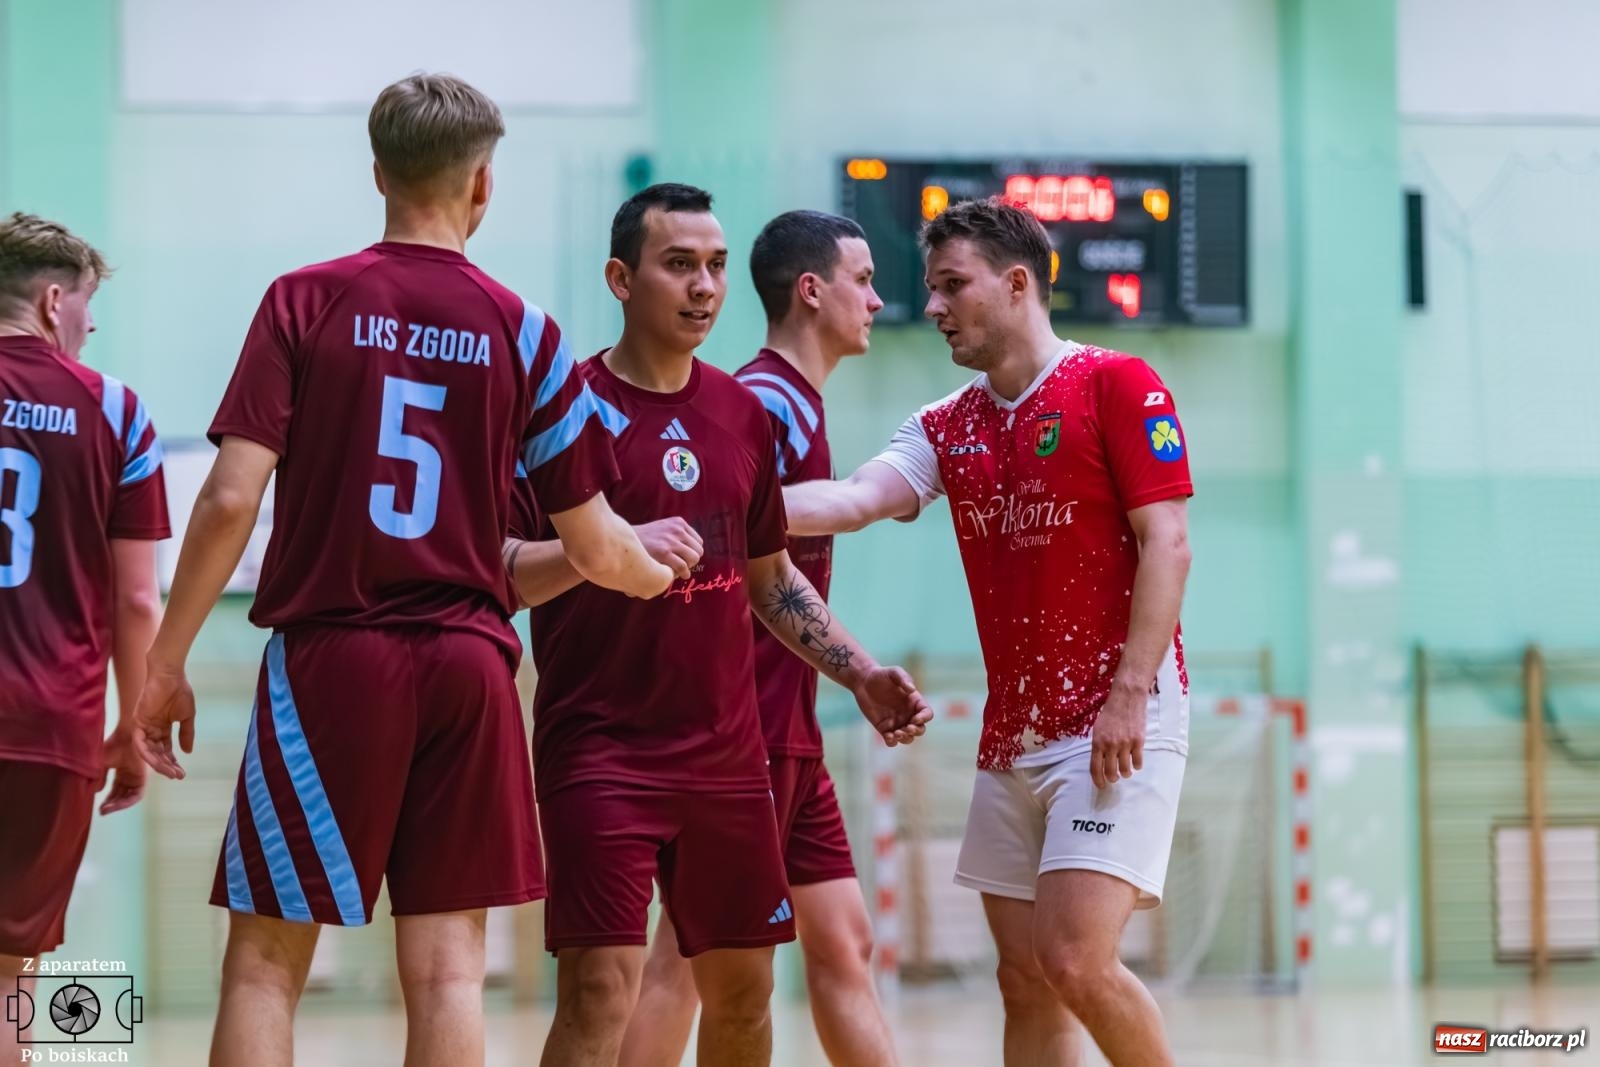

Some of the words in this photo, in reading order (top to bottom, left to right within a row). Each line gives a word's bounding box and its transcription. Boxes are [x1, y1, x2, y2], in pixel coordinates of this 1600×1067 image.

[354, 314, 399, 352] LKS
[405, 323, 491, 367] ZGODA
[1, 398, 78, 436] ZGODA
[369, 375, 447, 540] 5
[958, 493, 1078, 540] Wiktoria
